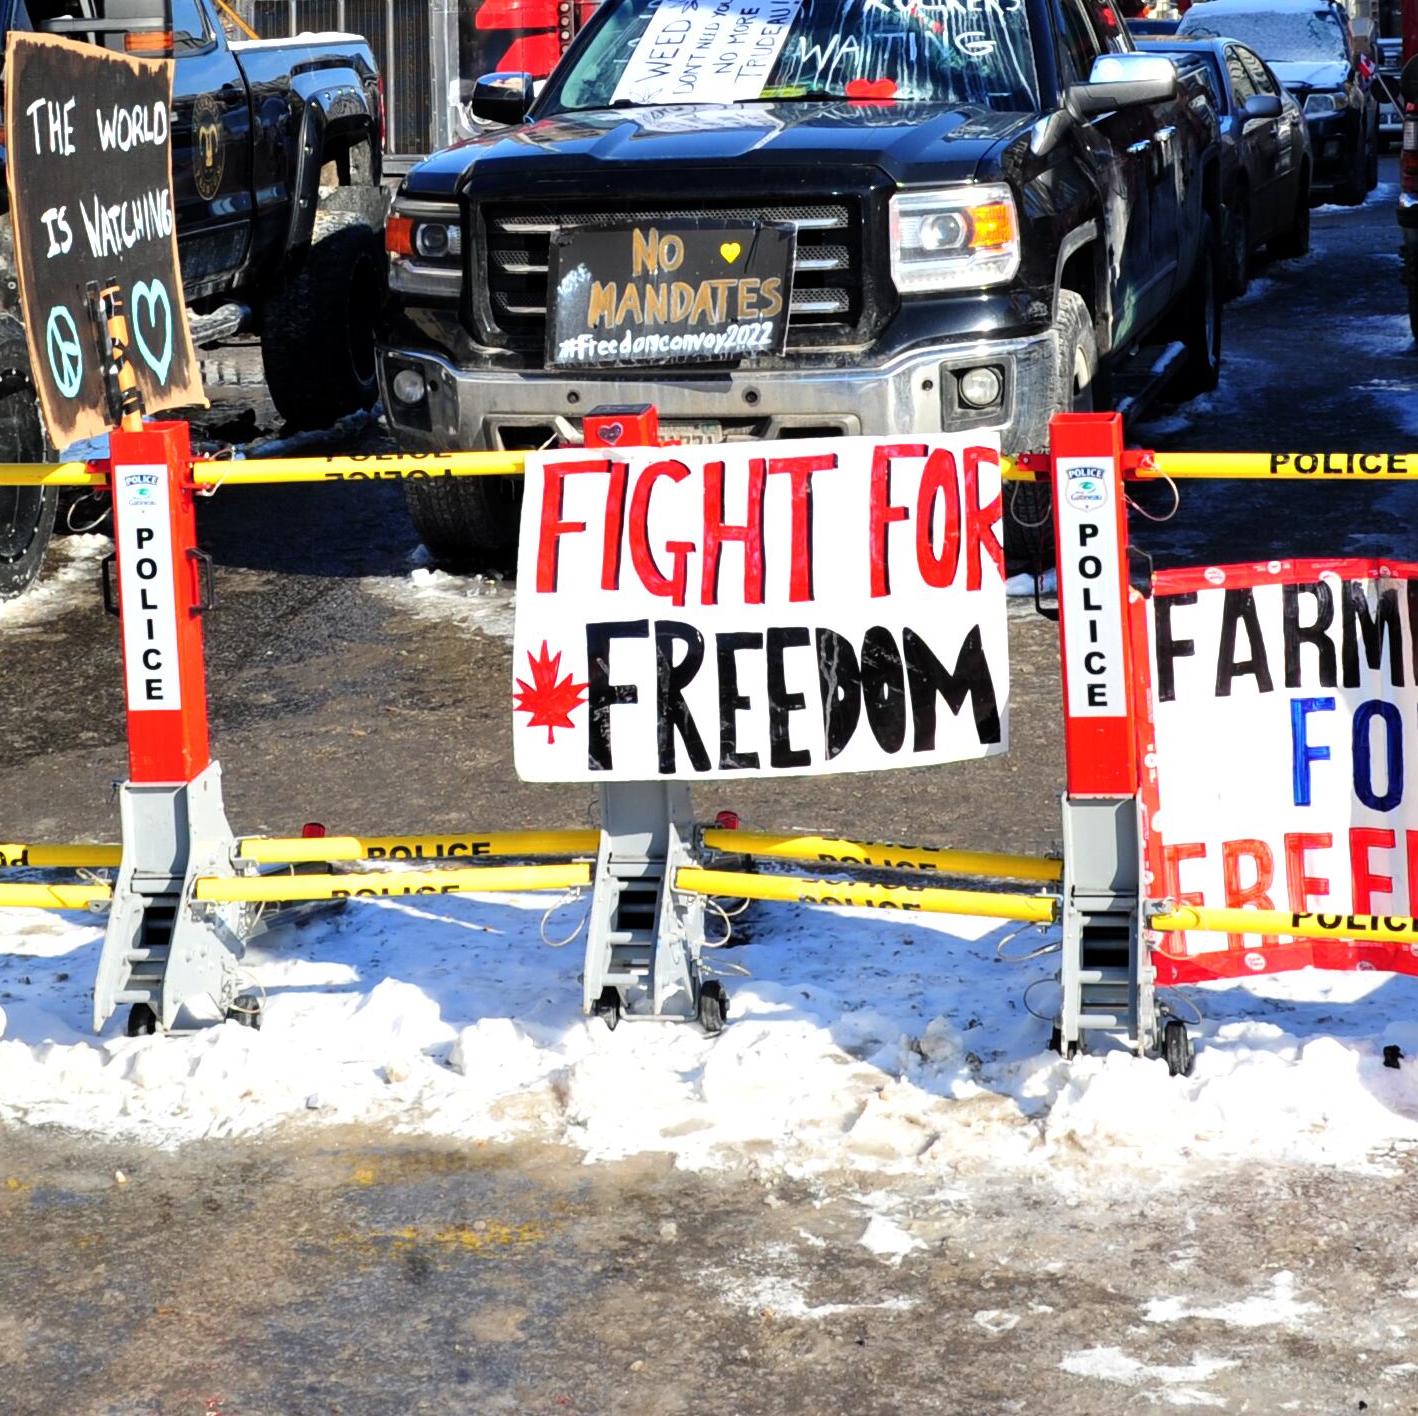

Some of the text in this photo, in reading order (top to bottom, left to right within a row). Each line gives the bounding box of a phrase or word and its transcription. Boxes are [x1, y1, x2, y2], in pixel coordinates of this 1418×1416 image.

[634, 19, 692, 83] WEED
[712, 51, 738, 74] NO
[797, 30, 997, 71] WAITING
[26, 96, 77, 156] THE
[96, 99, 169, 152] WORLD
[40, 188, 172, 259] IS WATCHING
[632, 227, 685, 277] NO
[587, 277, 783, 330] MANDATES
[1067, 467, 1103, 479] POLICE
[1270, 453, 1408, 474] POLICE
[536, 444, 1006, 606] FIGHT FOR
[135, 527, 164, 701] POLICE
[1078, 523, 1109, 707] POLICE
[585, 618, 1001, 774] FREEDOM
